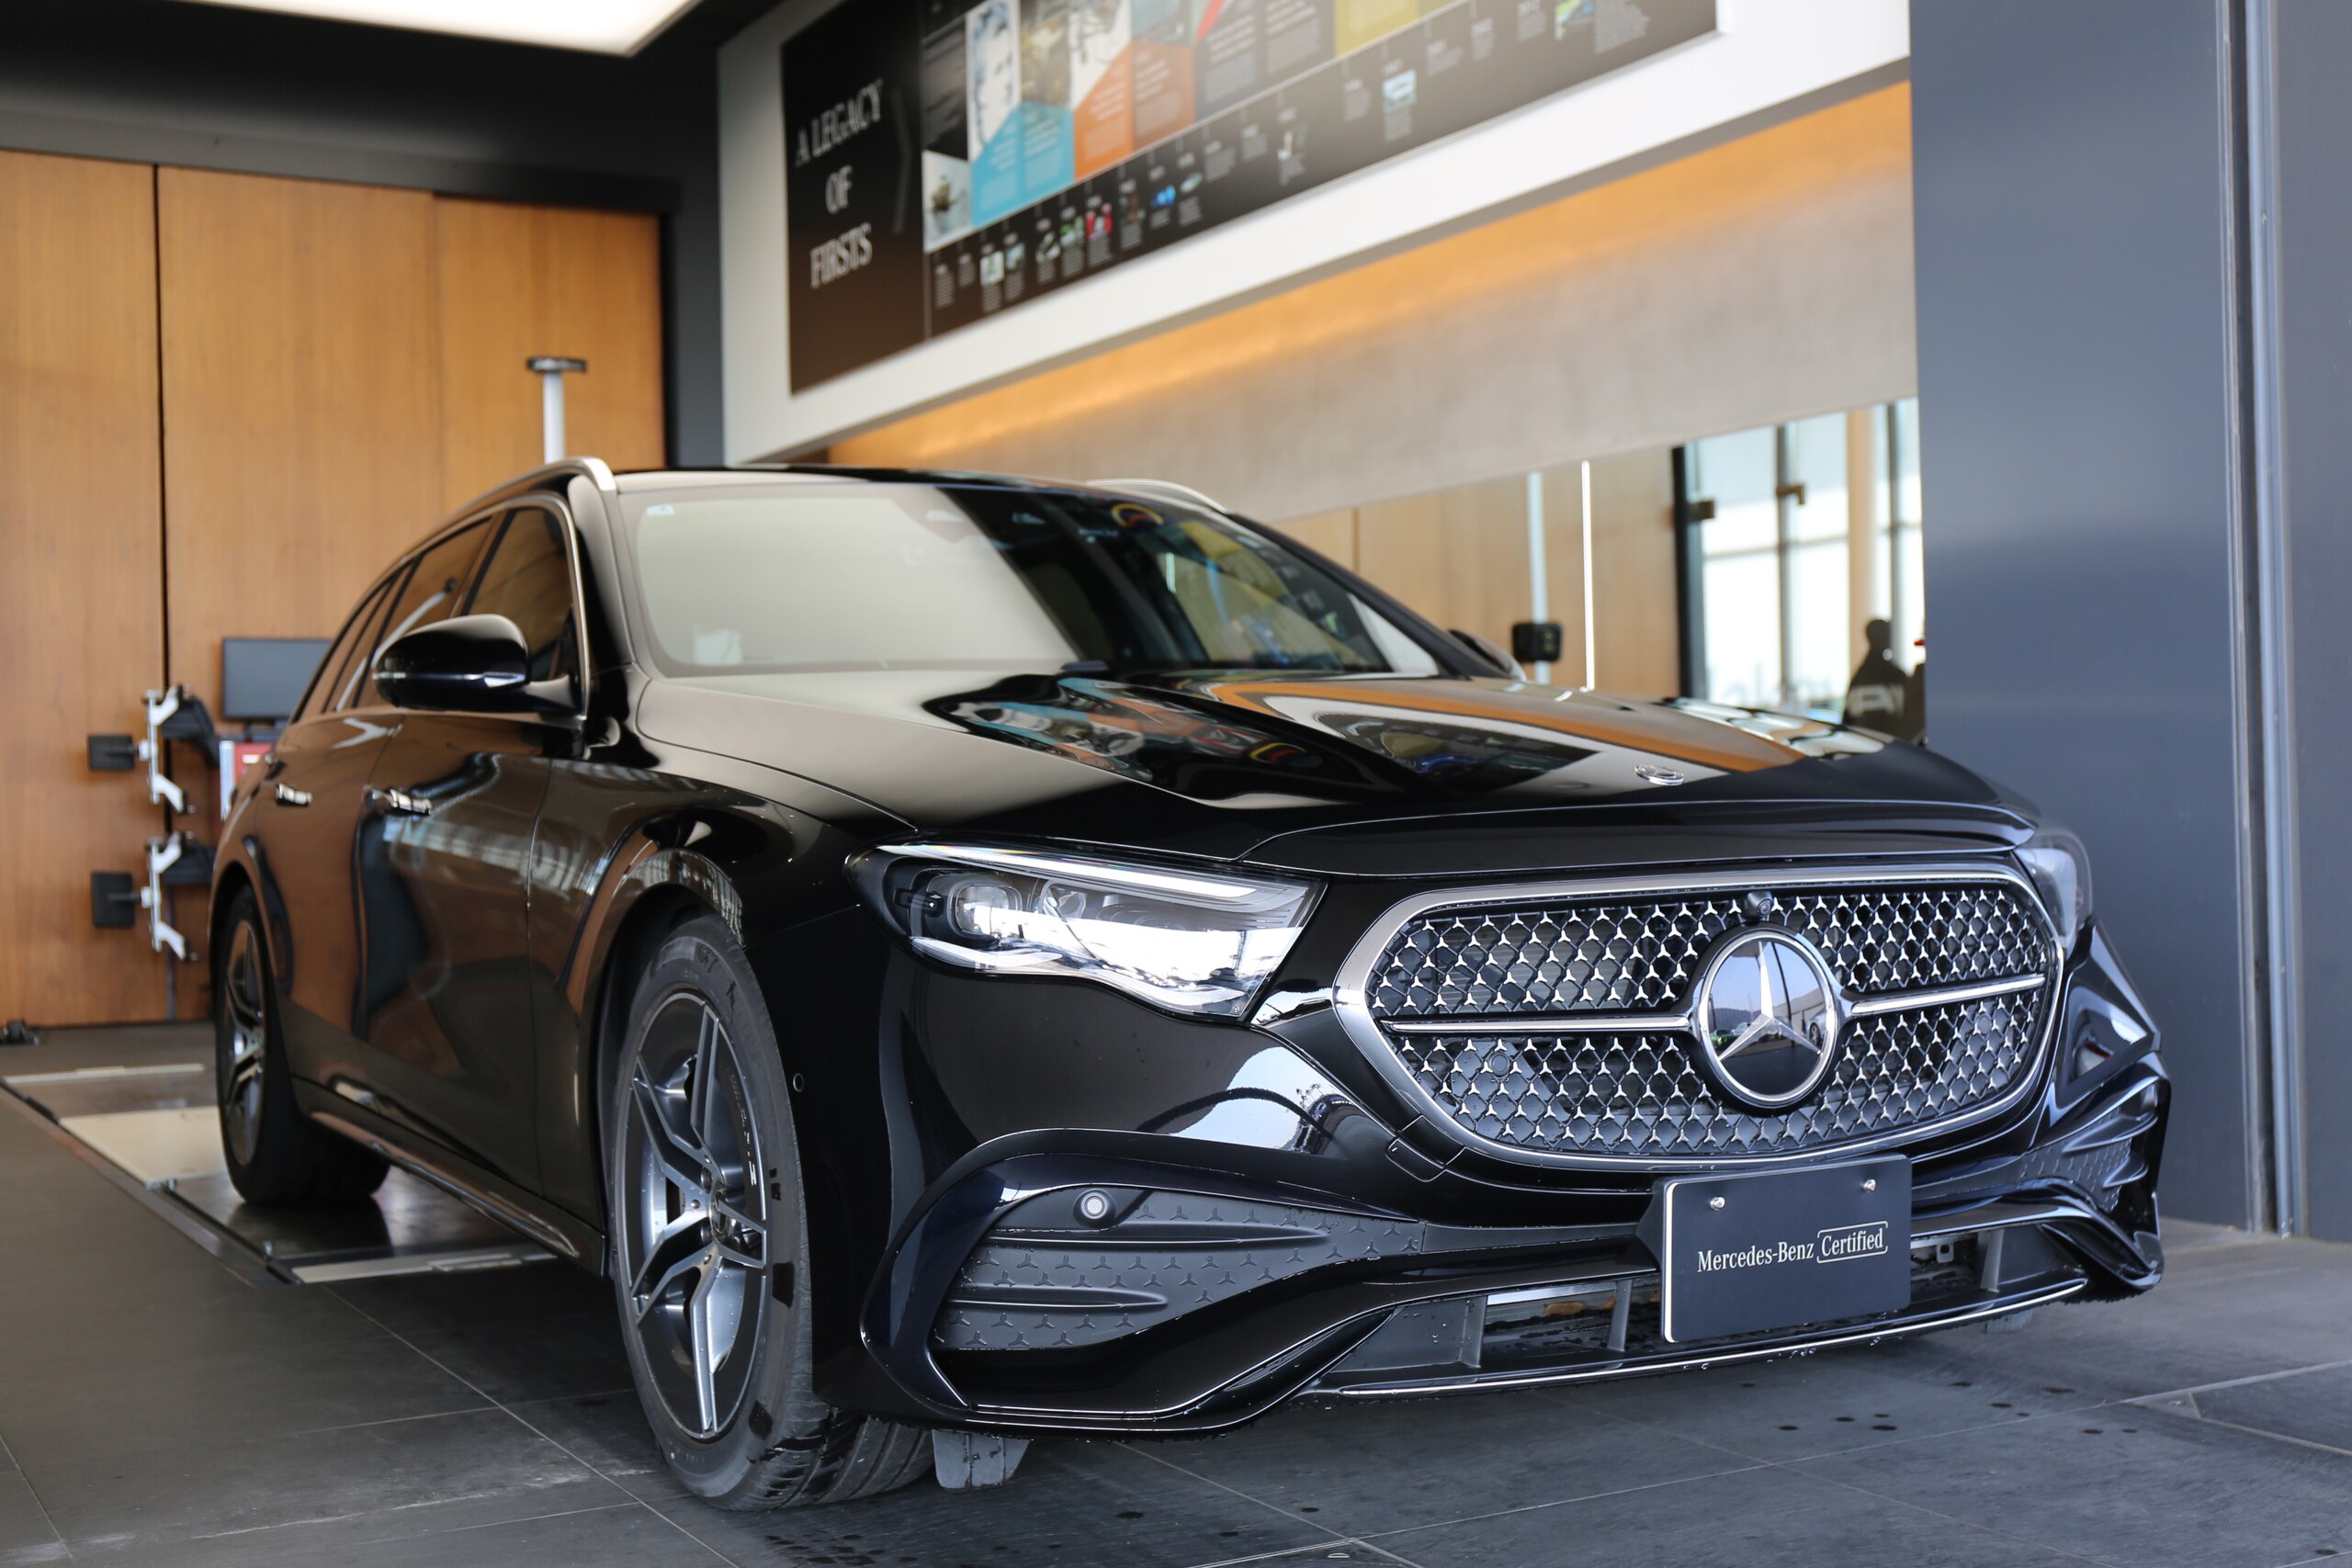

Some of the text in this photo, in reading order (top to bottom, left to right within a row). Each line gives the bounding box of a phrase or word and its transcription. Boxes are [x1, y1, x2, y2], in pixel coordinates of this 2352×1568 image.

[795, 127, 812, 167] A
[811, 78, 884, 158] LEGACY
[825, 164, 853, 215] OF
[810, 222, 873, 289] FIRSTS
[1697, 1227, 1883, 1273] Mercedes-Benz Certified
